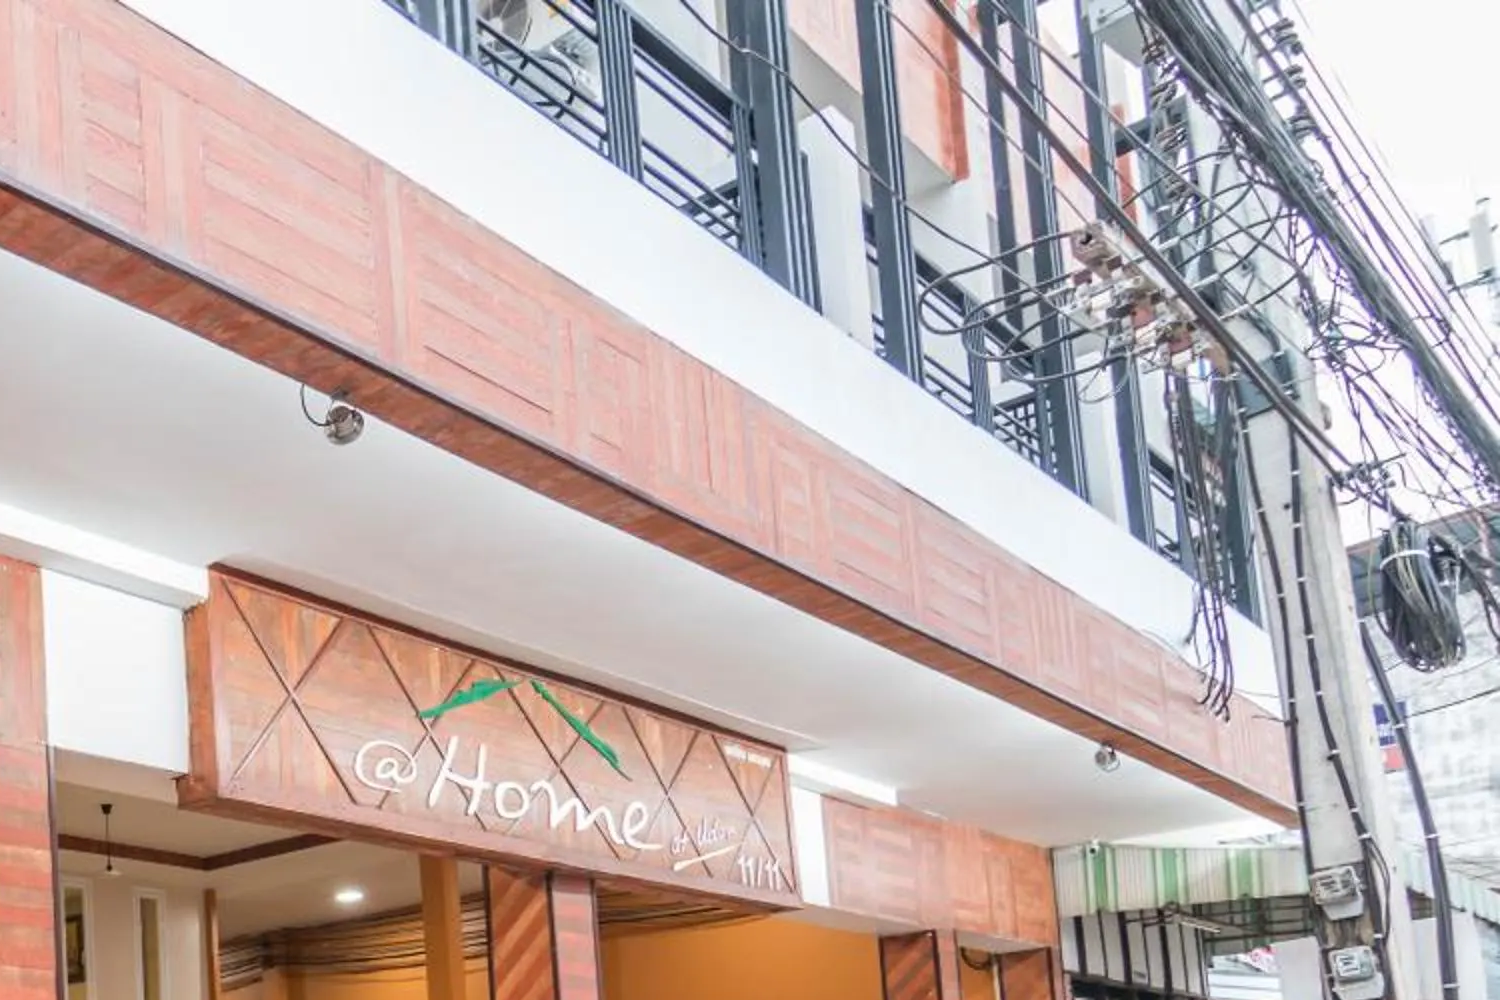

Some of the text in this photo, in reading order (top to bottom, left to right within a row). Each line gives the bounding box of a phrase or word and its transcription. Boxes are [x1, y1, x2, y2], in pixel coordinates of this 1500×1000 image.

[353, 739, 420, 793] @
[427, 735, 663, 852] Home
[669, 831, 690, 855] at
